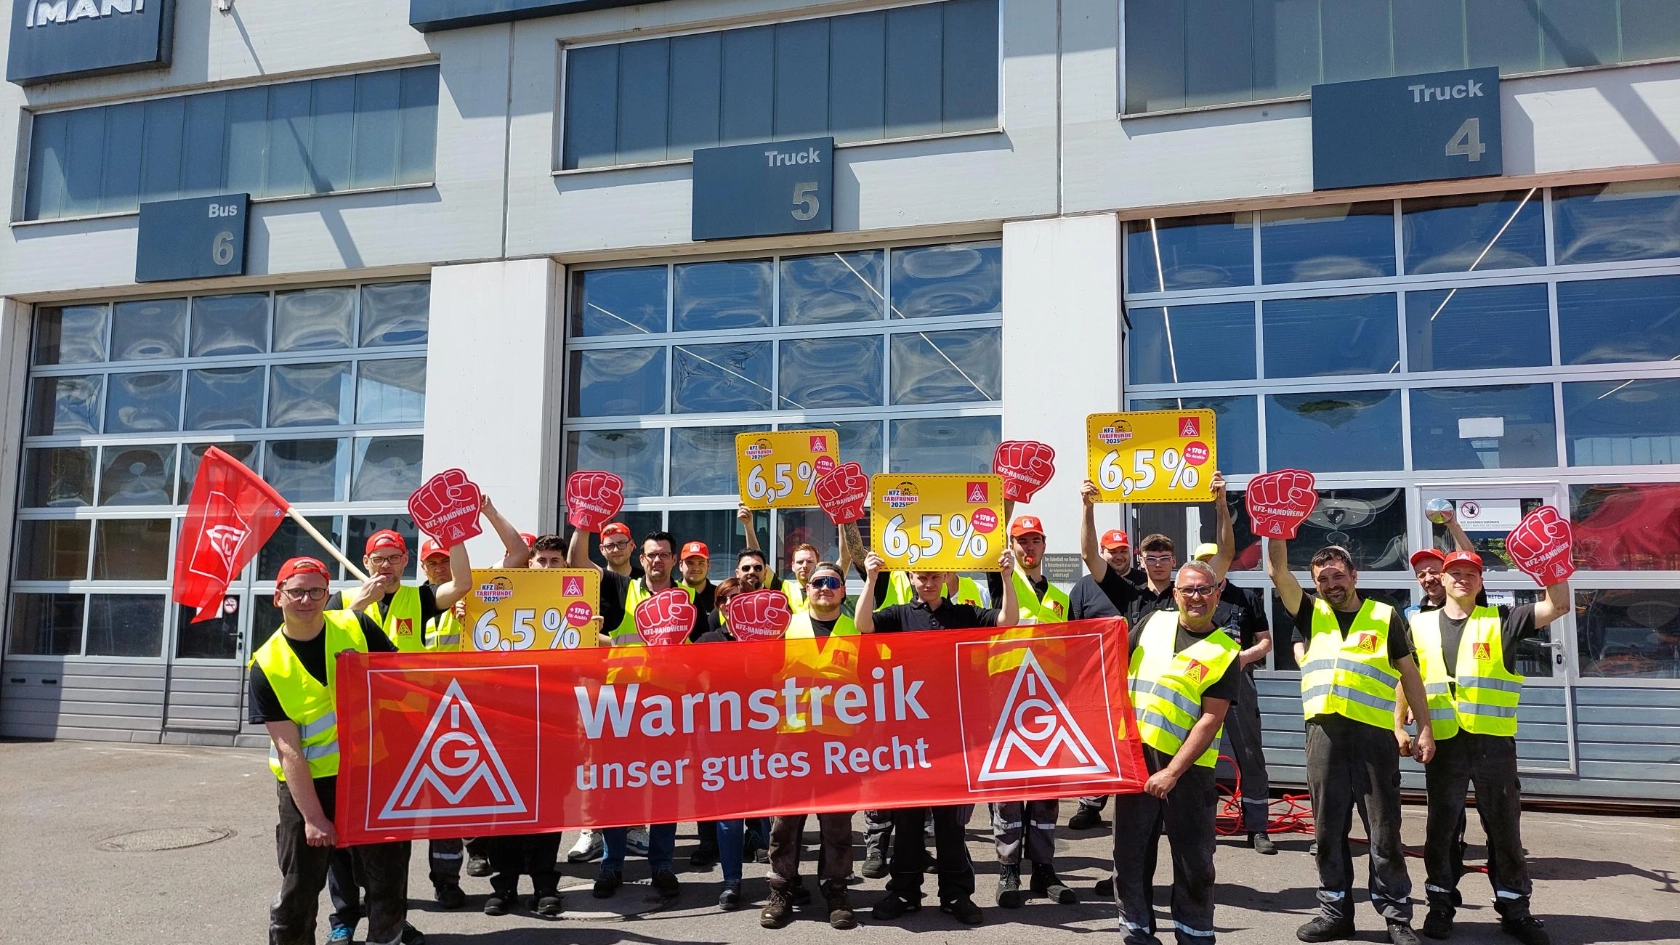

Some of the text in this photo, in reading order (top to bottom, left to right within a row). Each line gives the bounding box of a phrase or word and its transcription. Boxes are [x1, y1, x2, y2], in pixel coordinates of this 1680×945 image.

[36, 0, 133, 26] MAN
[1408, 79, 1484, 103] Truck
[1446, 117, 1486, 162] 4
[764, 147, 821, 167] Truck
[208, 203, 238, 218] Bus
[791, 182, 820, 221] 5
[213, 231, 234, 266] 6
[748, 463, 793, 504] 6,5
[1100, 447, 1199, 496] 6,5 %
[425, 503, 476, 529] KFZ-HANDWERK
[1252, 505, 1305, 517] KFZ-HANDWERK
[884, 513, 988, 564] 6,5 %
[1524, 541, 1569, 567] KFZ-HANDWERK
[474, 607, 581, 651] 6,5 %
[643, 624, 688, 636] KFZ-HANDWERK
[736, 624, 782, 636] KFZ-HANDWERK
[573, 665, 930, 740] Warnstreik
[576, 736, 932, 792] unser gutes Recht
